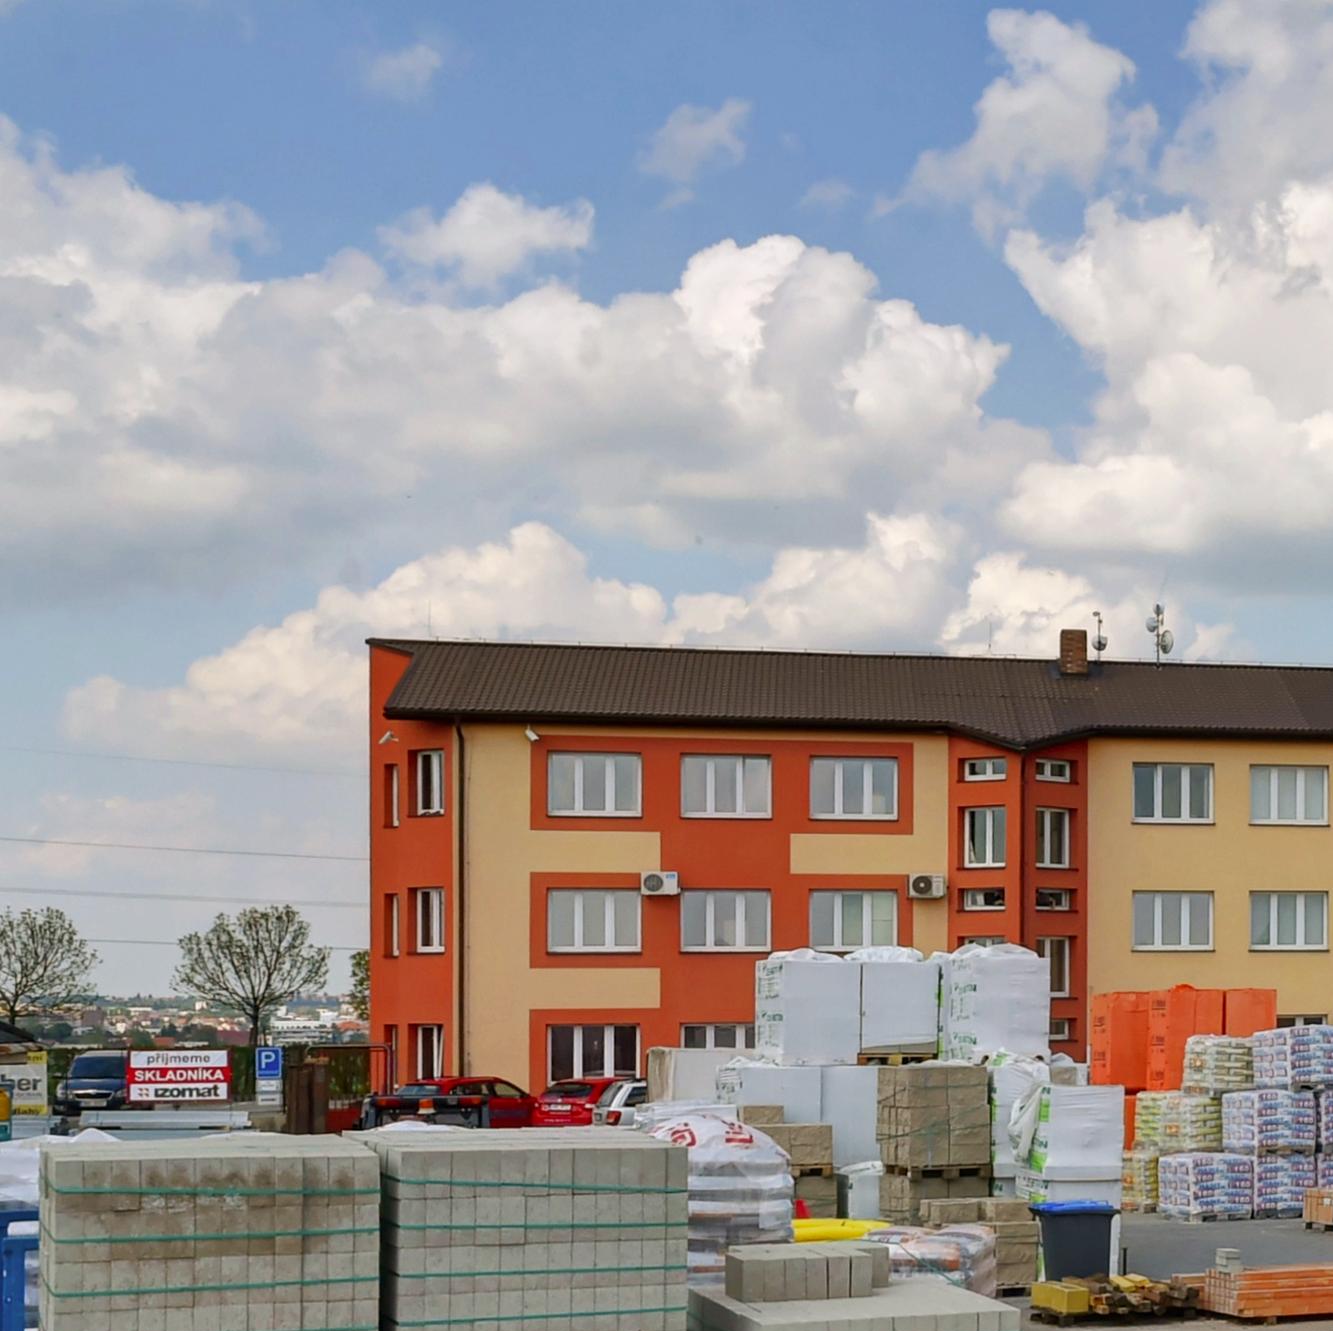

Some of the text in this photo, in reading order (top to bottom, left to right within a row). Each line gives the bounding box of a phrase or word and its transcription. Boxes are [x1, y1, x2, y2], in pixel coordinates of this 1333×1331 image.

[260, 1051, 275, 1068] P
[134, 1068, 224, 1082] SKLADNÍKA
[154, 1084, 221, 1098] izomat
